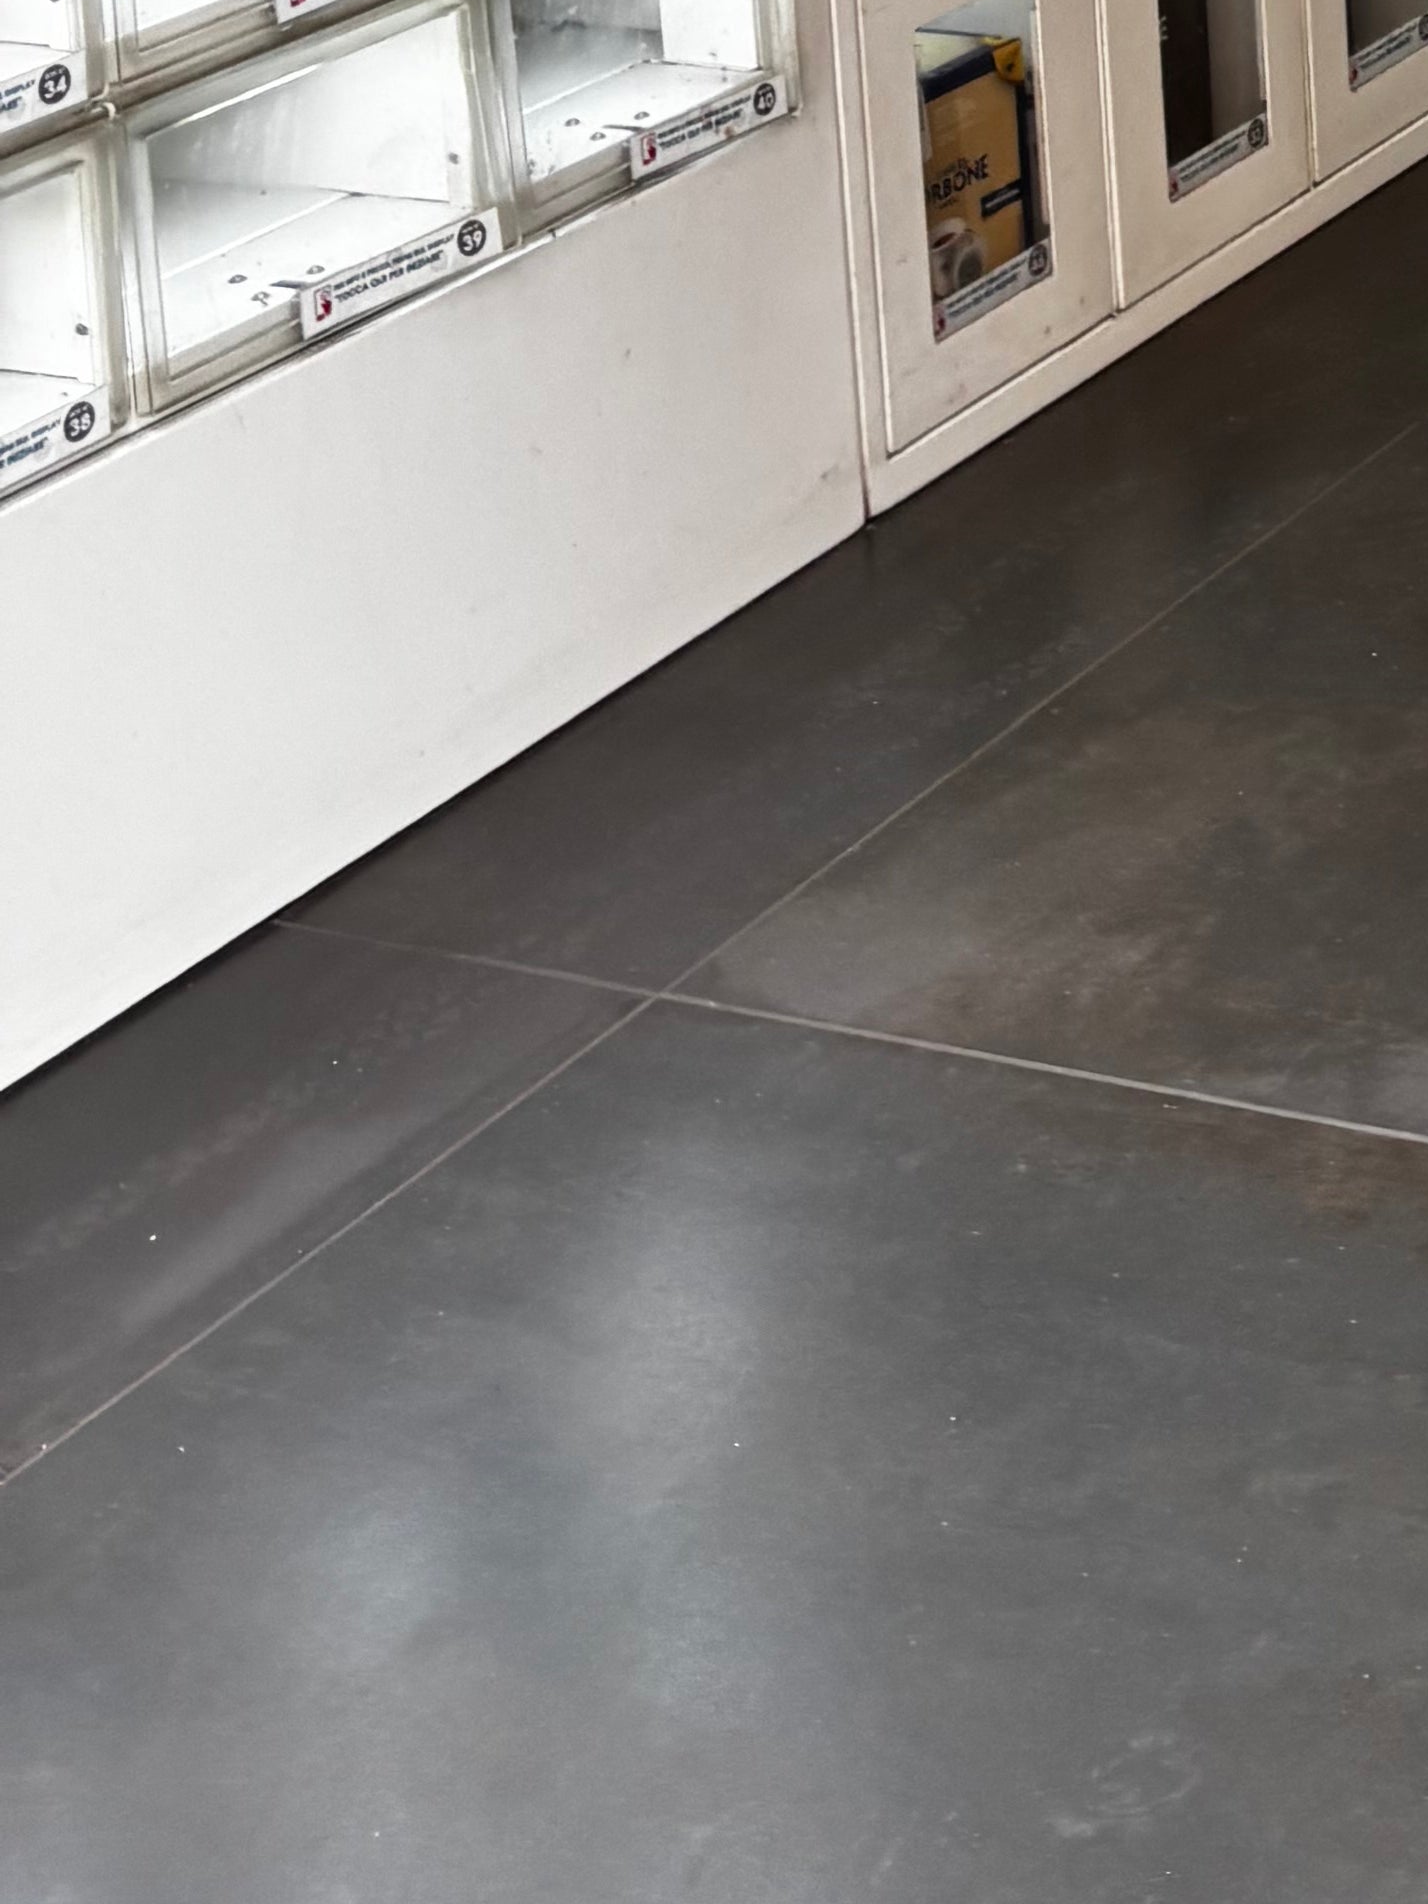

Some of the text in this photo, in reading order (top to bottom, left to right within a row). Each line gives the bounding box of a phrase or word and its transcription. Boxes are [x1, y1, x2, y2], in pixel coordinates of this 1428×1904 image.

[43, 74, 67, 99] 34
[462, 229, 482, 253] 39
[69, 412, 91, 437] 38
